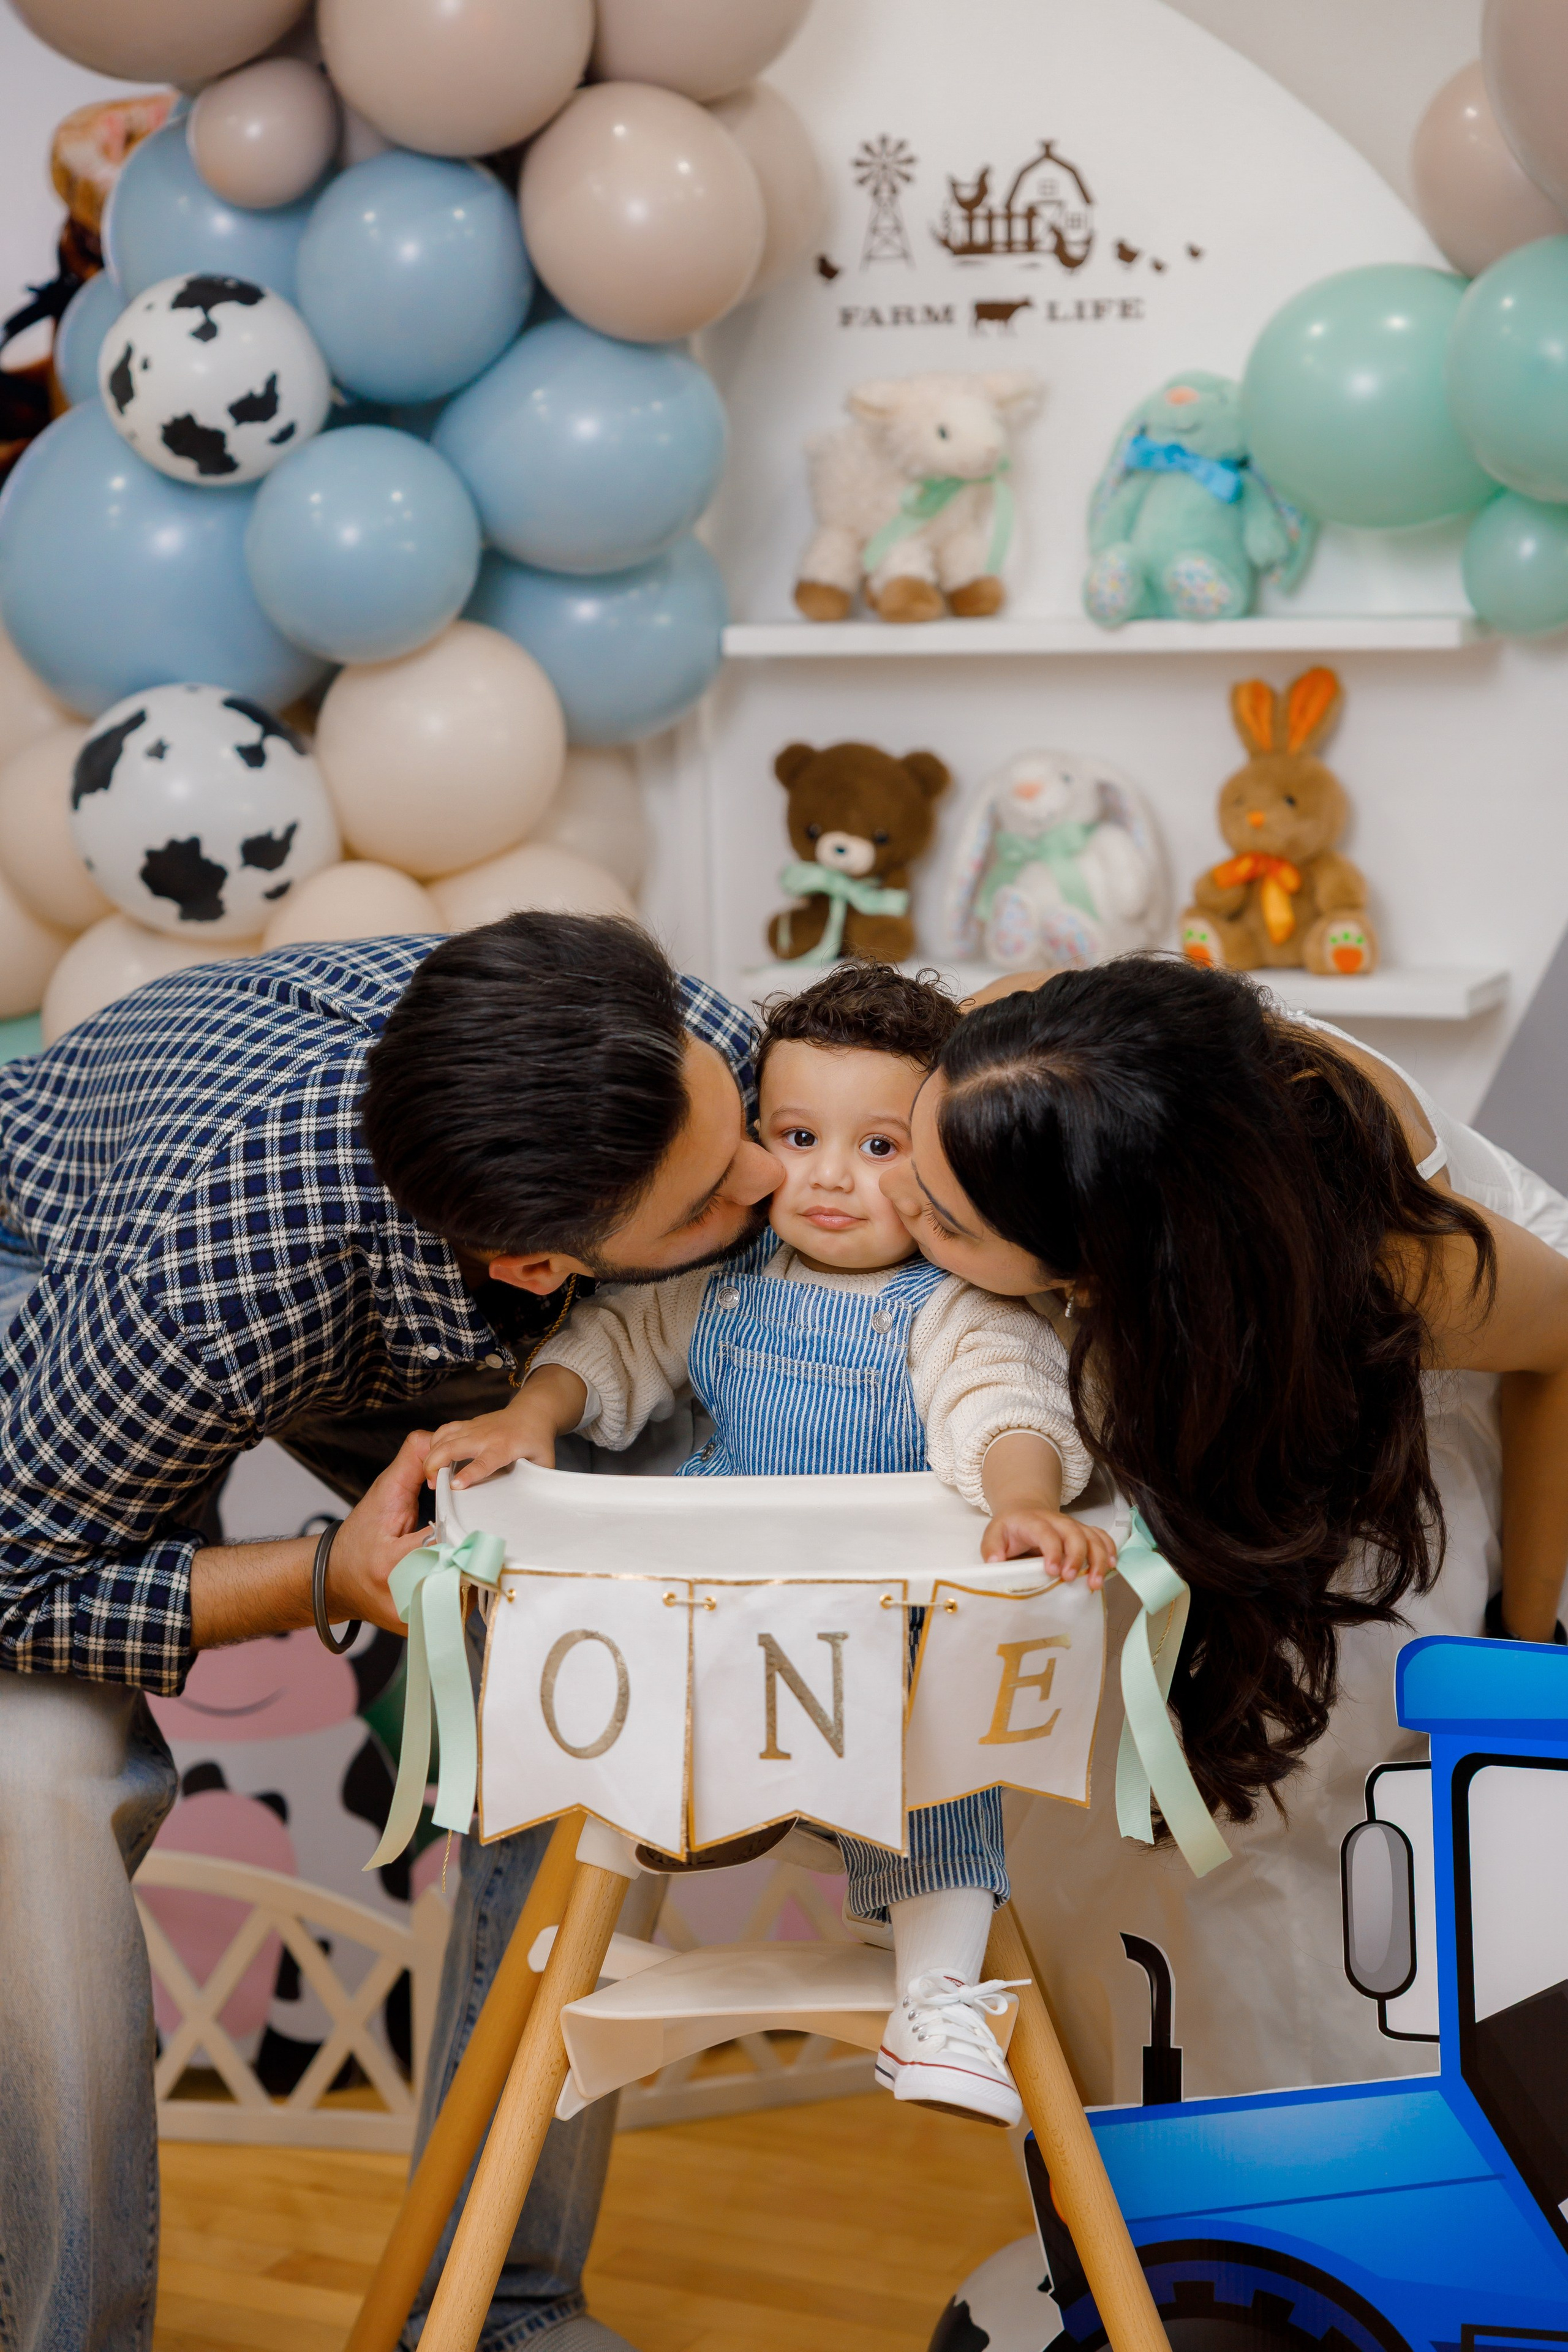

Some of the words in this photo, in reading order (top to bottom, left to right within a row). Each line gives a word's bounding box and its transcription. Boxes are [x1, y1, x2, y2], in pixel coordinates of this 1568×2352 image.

[840, 305, 954, 327] FARM
[1047, 296, 1144, 321] LIFE
[540, 1629, 1072, 1760] ONE
